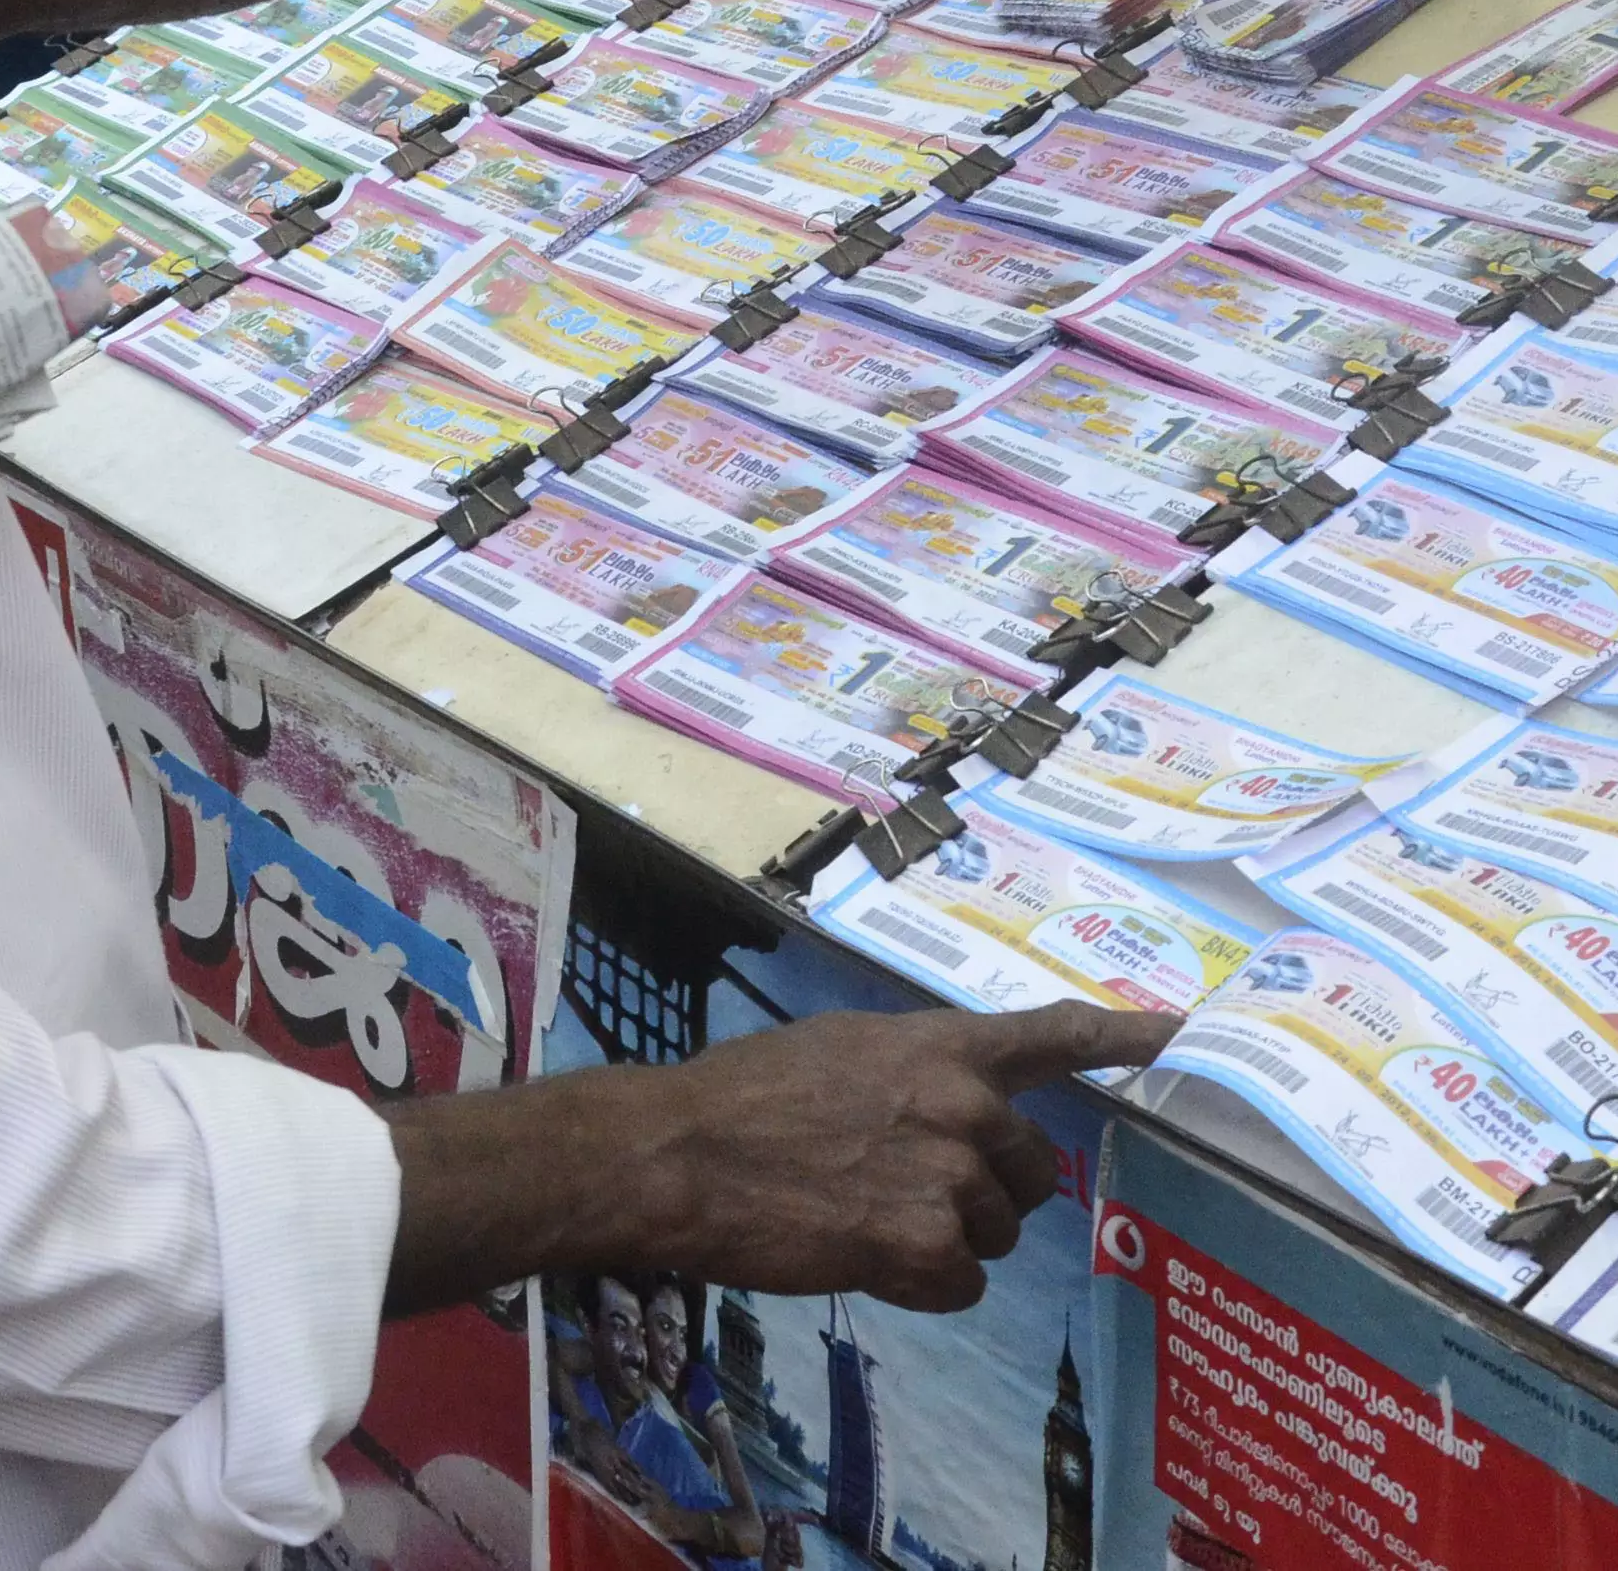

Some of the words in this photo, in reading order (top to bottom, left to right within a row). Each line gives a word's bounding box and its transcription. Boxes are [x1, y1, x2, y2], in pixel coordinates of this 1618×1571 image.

[1121, 176, 1175, 198] LAKH
[987, 266, 1037, 287] LAKH
[843, 366, 895, 390] LAKH
[720, 468, 761, 489] LAKH
[587, 564, 638, 592] LAKH
[1516, 586, 1563, 609] LAKH
[1080, 881, 1112, 901] Lottery
[1094, 938, 1141, 969] LAKH
[1431, 1012, 1471, 1047] Lottery
[1459, 1101, 1520, 1151] LAKH
[1337, 1493, 1380, 1540] 1000
